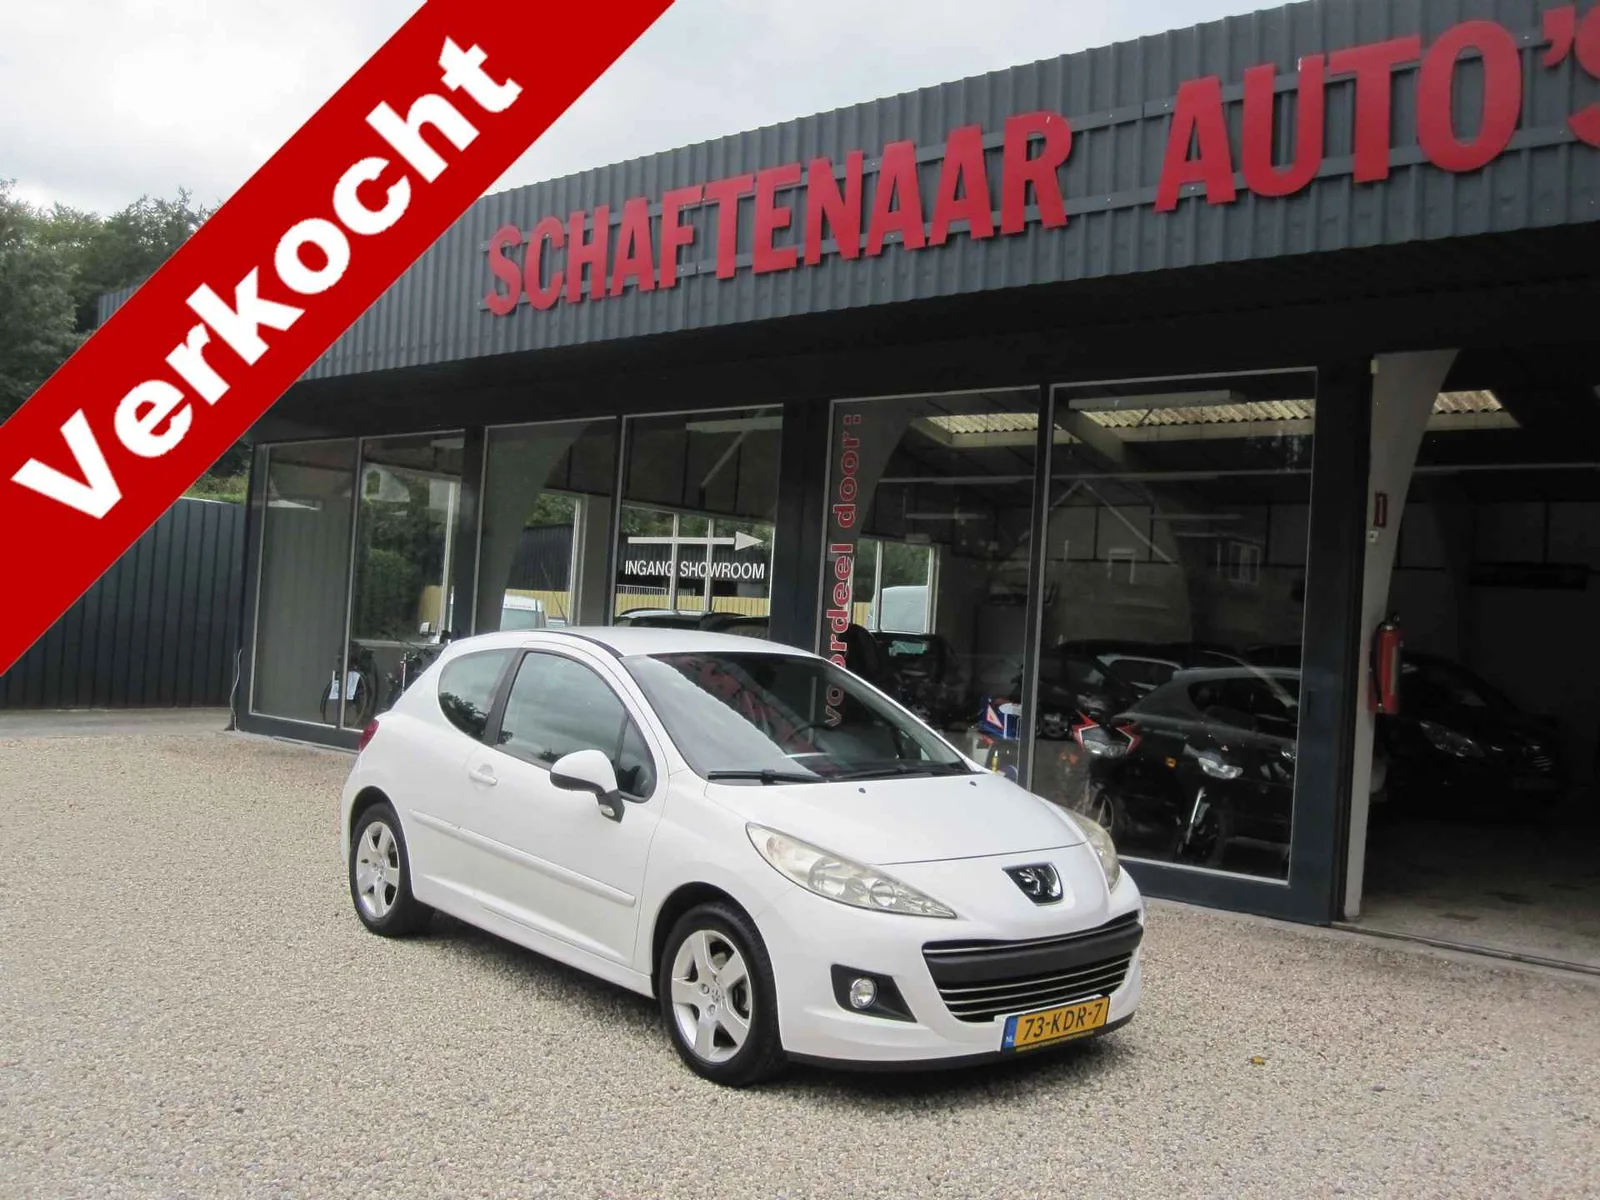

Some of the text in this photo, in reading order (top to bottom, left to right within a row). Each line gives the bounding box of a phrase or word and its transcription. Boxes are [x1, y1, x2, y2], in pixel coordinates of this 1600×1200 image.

[485, 111, 1073, 316] SCHAFTENAAR
[625, 560, 765, 579] INGANG SHOWROOM
[1022, 1003, 1103, 1040] 73-KDR-7
